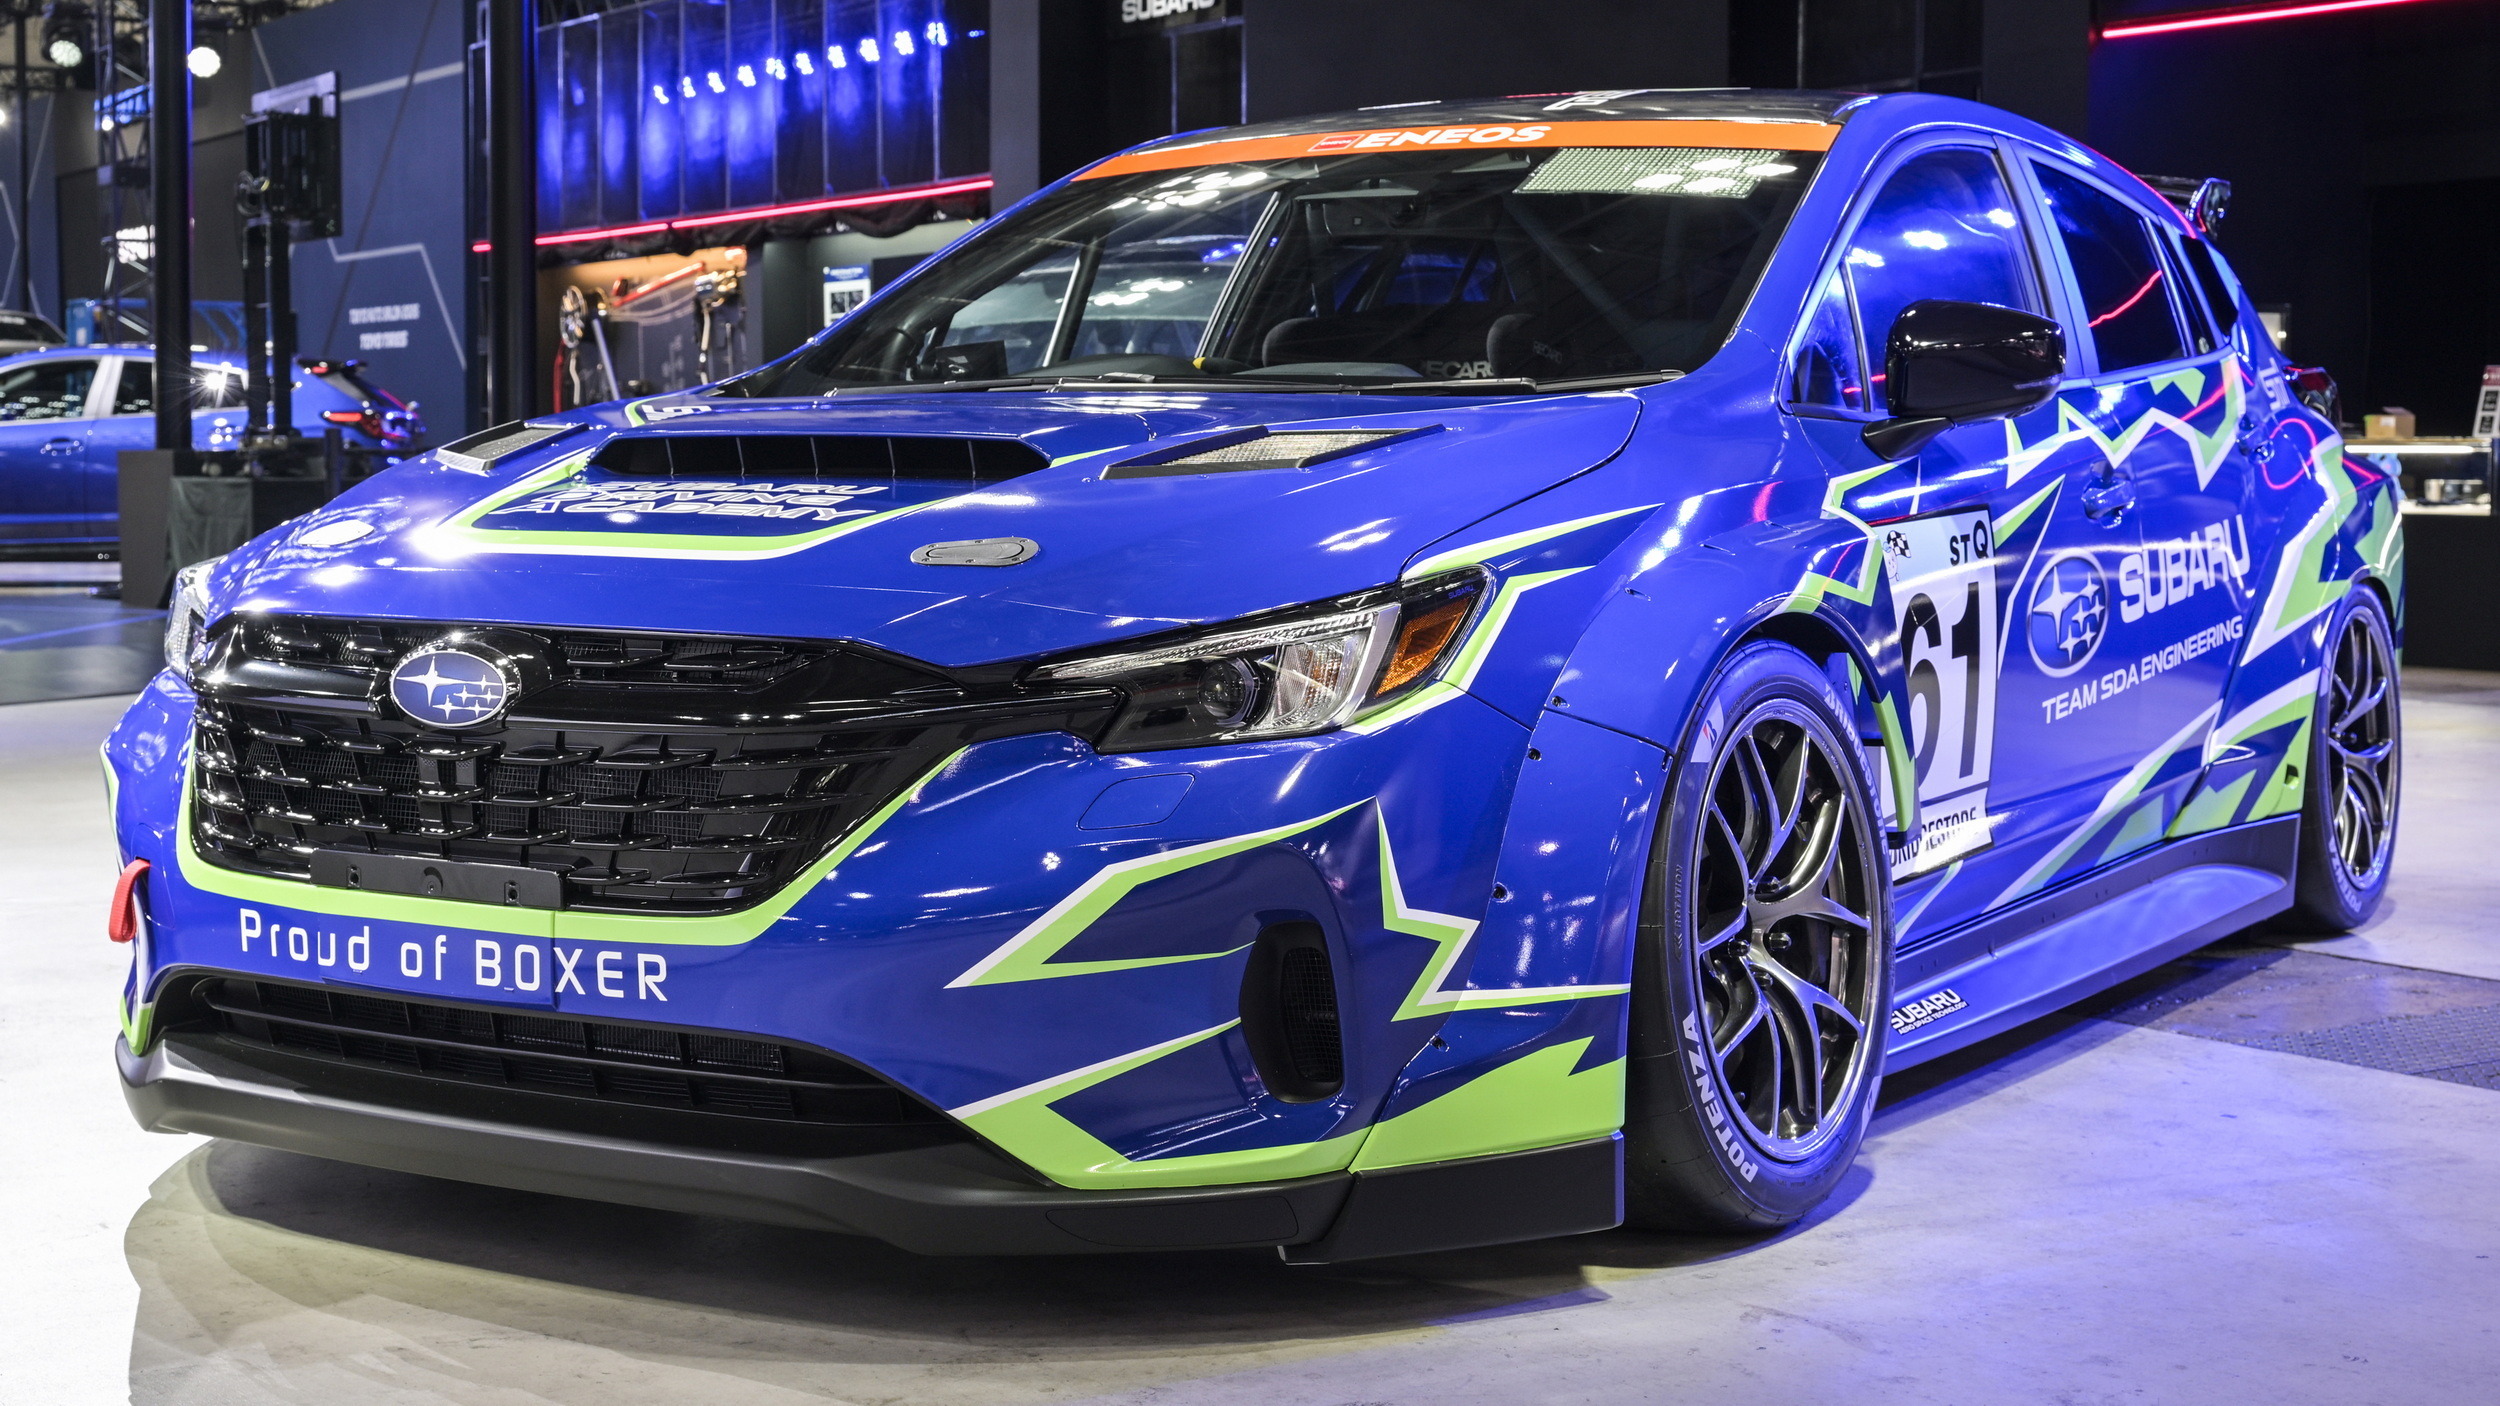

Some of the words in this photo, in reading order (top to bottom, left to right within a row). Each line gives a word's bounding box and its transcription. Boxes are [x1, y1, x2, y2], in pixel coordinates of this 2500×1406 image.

[1353, 125, 1552, 149] ENEOS
[1425, 360, 1494, 379] ECAR
[531, 489, 855, 507] DRIVING
[592, 481, 890, 495] SUBARU
[488, 501, 877, 521] ACADEMY
[2118, 513, 2251, 624] SUBARU
[1448, 584, 1474, 599] SUBARU
[1900, 581, 1980, 789] 61
[2042, 680, 2098, 724] TEAM
[2101, 663, 2140, 700] SDA
[2141, 615, 2244, 682] ENGINEERING
[239, 907, 370, 972] Proud
[400, 934, 447, 981] of
[475, 938, 669, 1002] BOXER
[1891, 988, 1961, 1030] SUBARU
[1682, 1009, 1759, 1183] POTENZA
